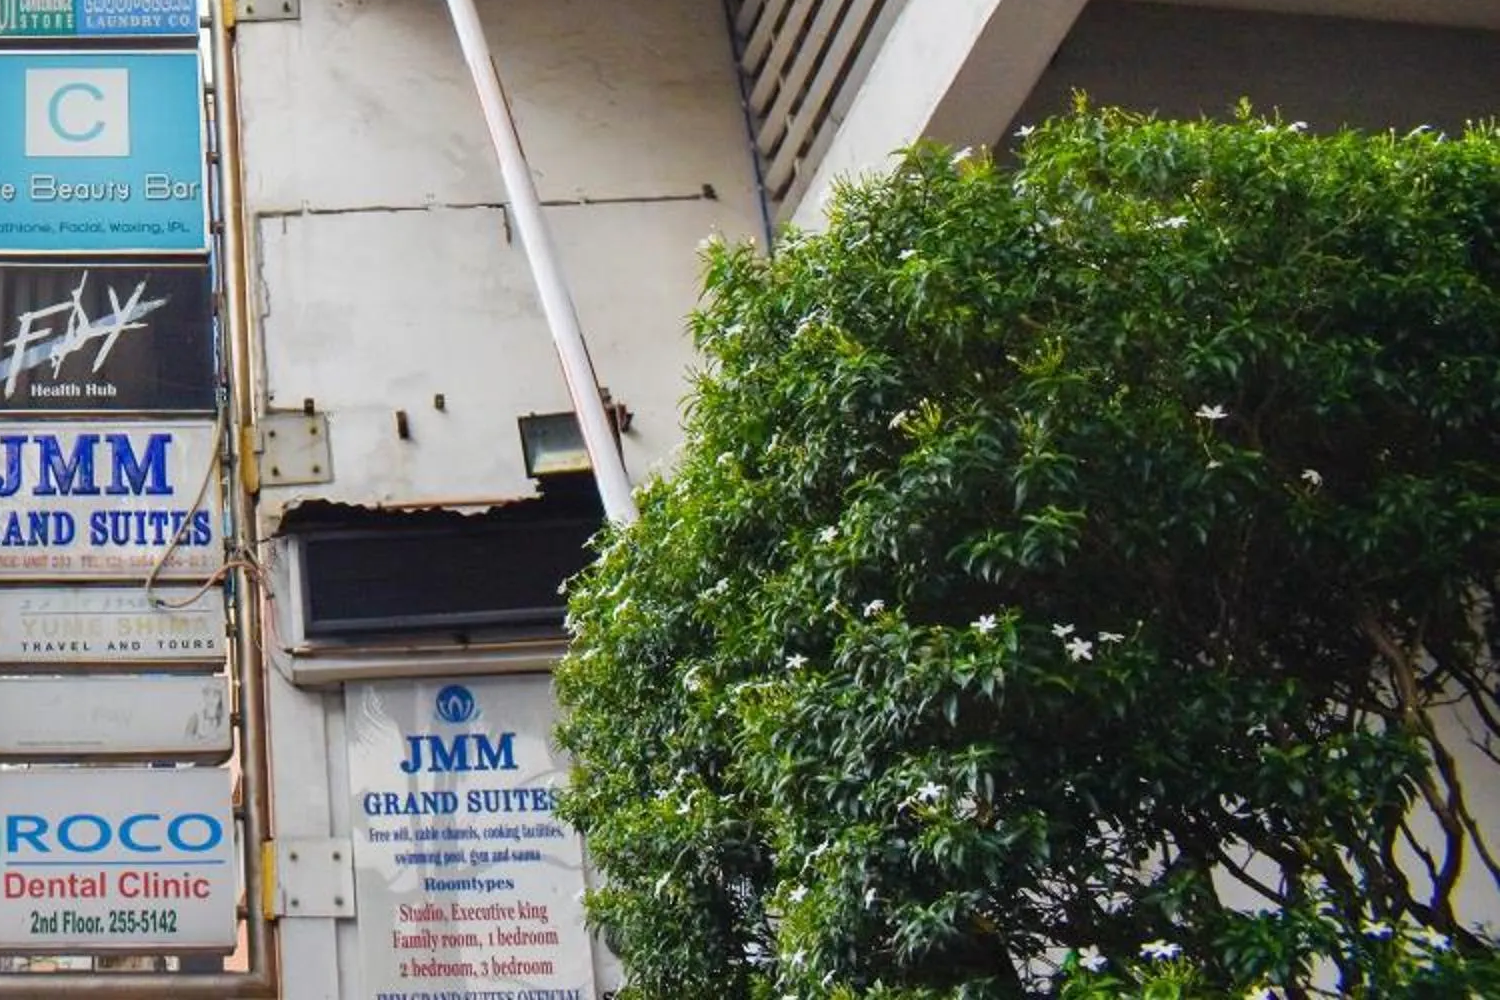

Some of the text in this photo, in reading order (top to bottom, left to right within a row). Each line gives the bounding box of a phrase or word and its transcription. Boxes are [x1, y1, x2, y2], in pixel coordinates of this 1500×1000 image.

[19, 14, 74, 29] STORE
[86, 15, 162, 28] LAUNDRY
[31, 174, 131, 201] Beauty
[145, 173, 199, 200] Bar
[109, 220, 165, 235] Waxing,
[31, 383, 117, 398] Health Hub
[90, 511, 212, 547] SUITES
[22, 640, 215, 651] TRAVEL AND TOURS
[400, 732, 519, 773] JMM
[363, 791, 459, 815] GRAND
[6, 814, 222, 852] ROCO
[5, 872, 211, 899] Dental Clinic
[424, 877, 514, 893] Roomtypes
[30, 911, 58, 934] 2nd
[109, 909, 177, 933] 255-5142
[451, 903, 515, 921] Executive
[518, 901, 549, 923] king
[393, 930, 440, 952] Family
[442, 931, 483, 949] room,
[497, 928, 559, 946] bedroom
[400, 961, 408, 978] 2
[480, 960, 489, 977] 3
[492, 955, 554, 976] bedroom
